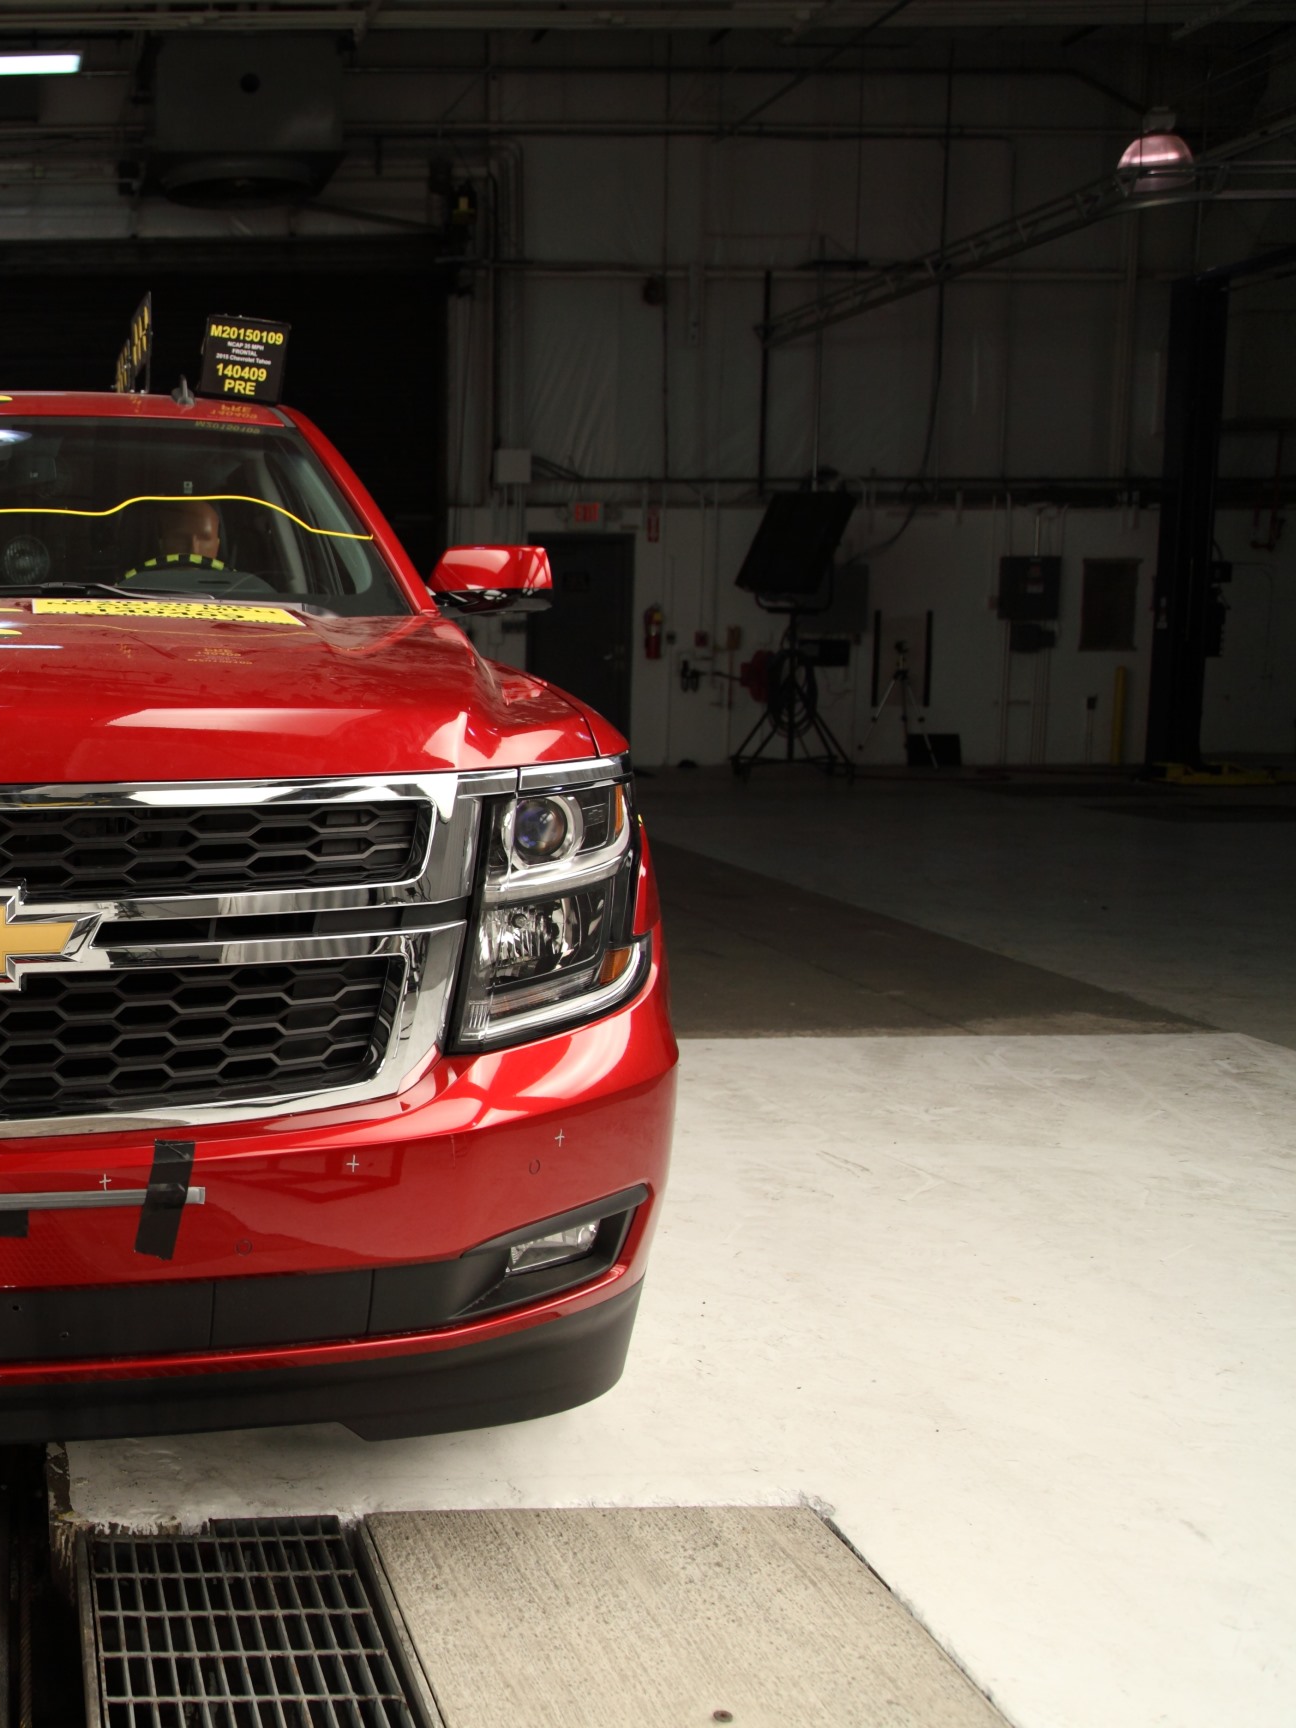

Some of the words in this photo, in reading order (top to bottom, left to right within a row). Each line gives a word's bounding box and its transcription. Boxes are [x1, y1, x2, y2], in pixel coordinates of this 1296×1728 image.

[210, 324, 284, 345] M20150109
[229, 355, 255, 363] Chevrolet
[256, 357, 272, 365] Tahoe
[232, 348, 257, 357] FRONTAL
[216, 363, 267, 381] 140409
[224, 379, 256, 395] PRE
